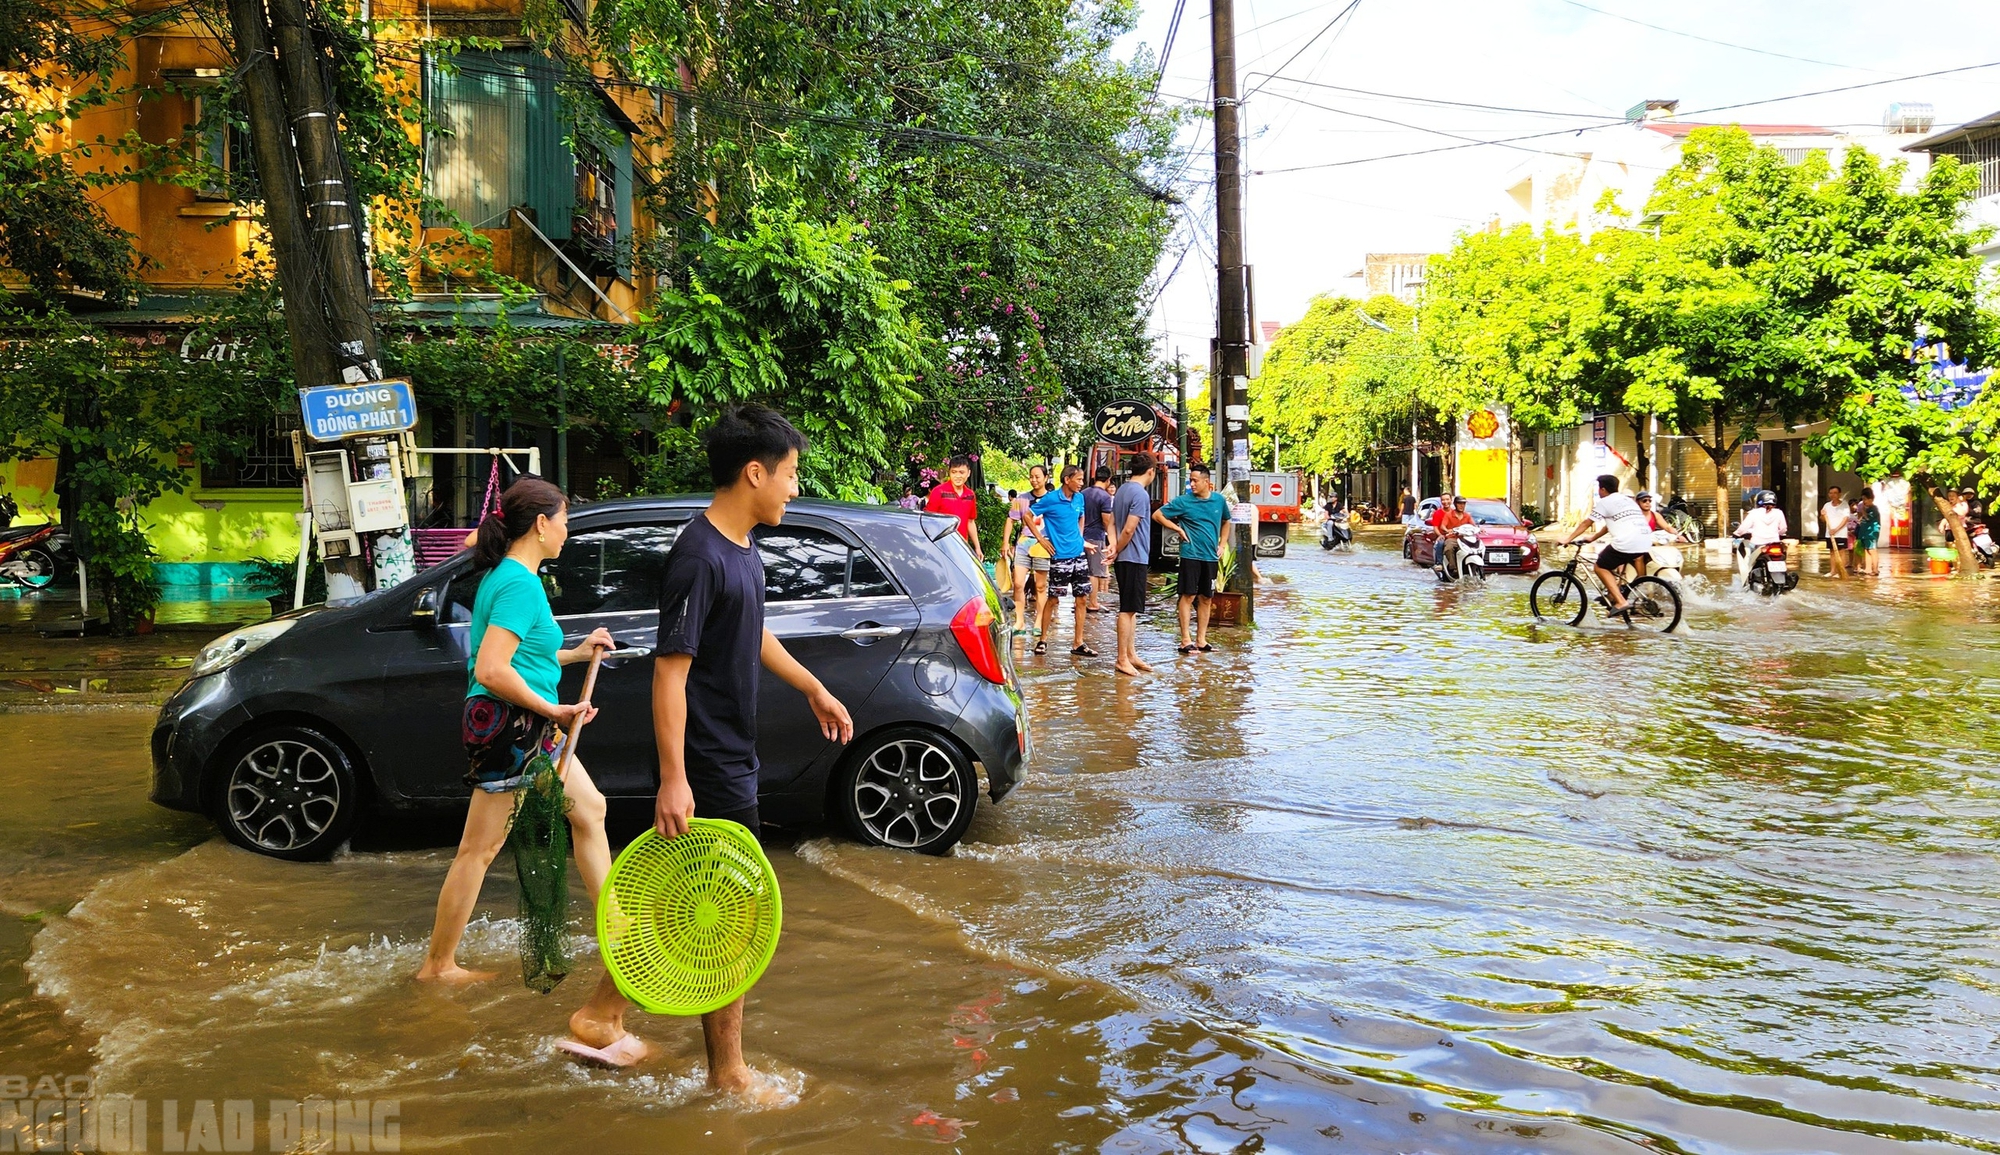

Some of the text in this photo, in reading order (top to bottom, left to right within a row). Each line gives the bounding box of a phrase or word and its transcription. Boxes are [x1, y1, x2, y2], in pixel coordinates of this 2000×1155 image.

[326, 388, 391, 408] ĐƯỜNG
[317, 407, 408, 434] ĐÔNG PHÁT 1
[1101, 415, 1154, 437] Coffee
[1262, 537, 1280, 547] SP
